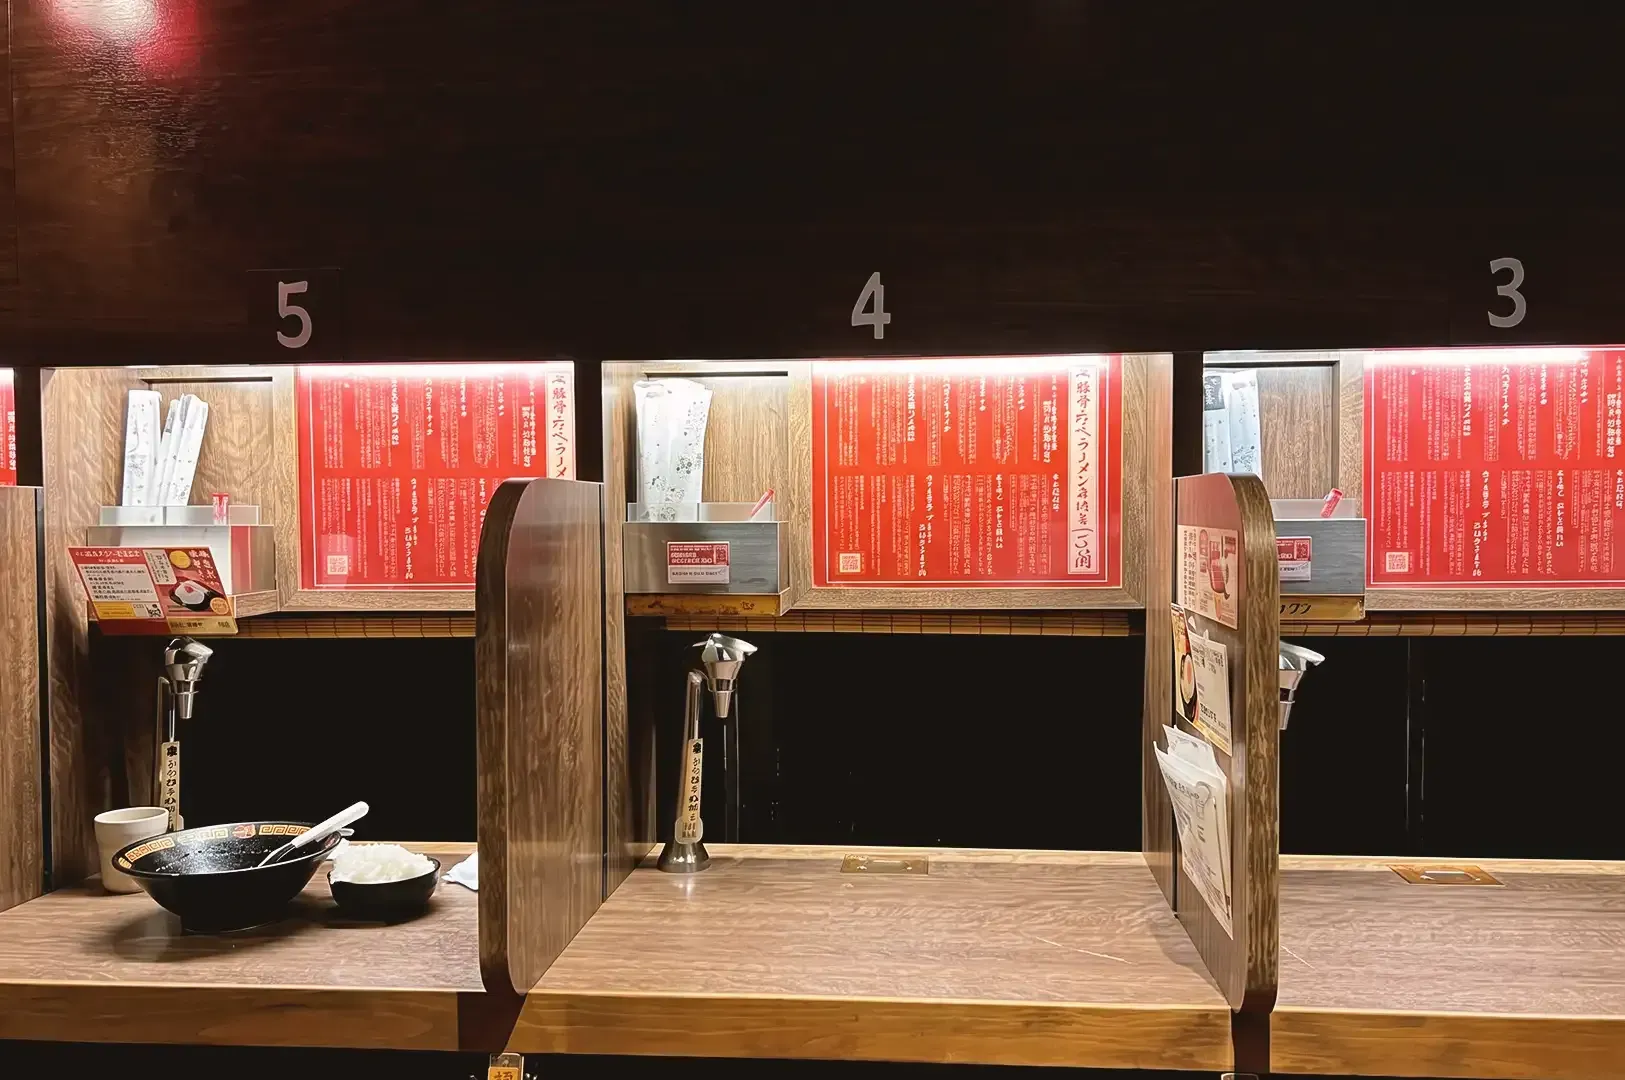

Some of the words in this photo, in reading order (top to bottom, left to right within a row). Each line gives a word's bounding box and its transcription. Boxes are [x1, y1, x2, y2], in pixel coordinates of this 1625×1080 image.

[277, 281, 312, 348] 5
[852, 272, 891, 339] 4
[1488, 258, 1526, 328] 3
